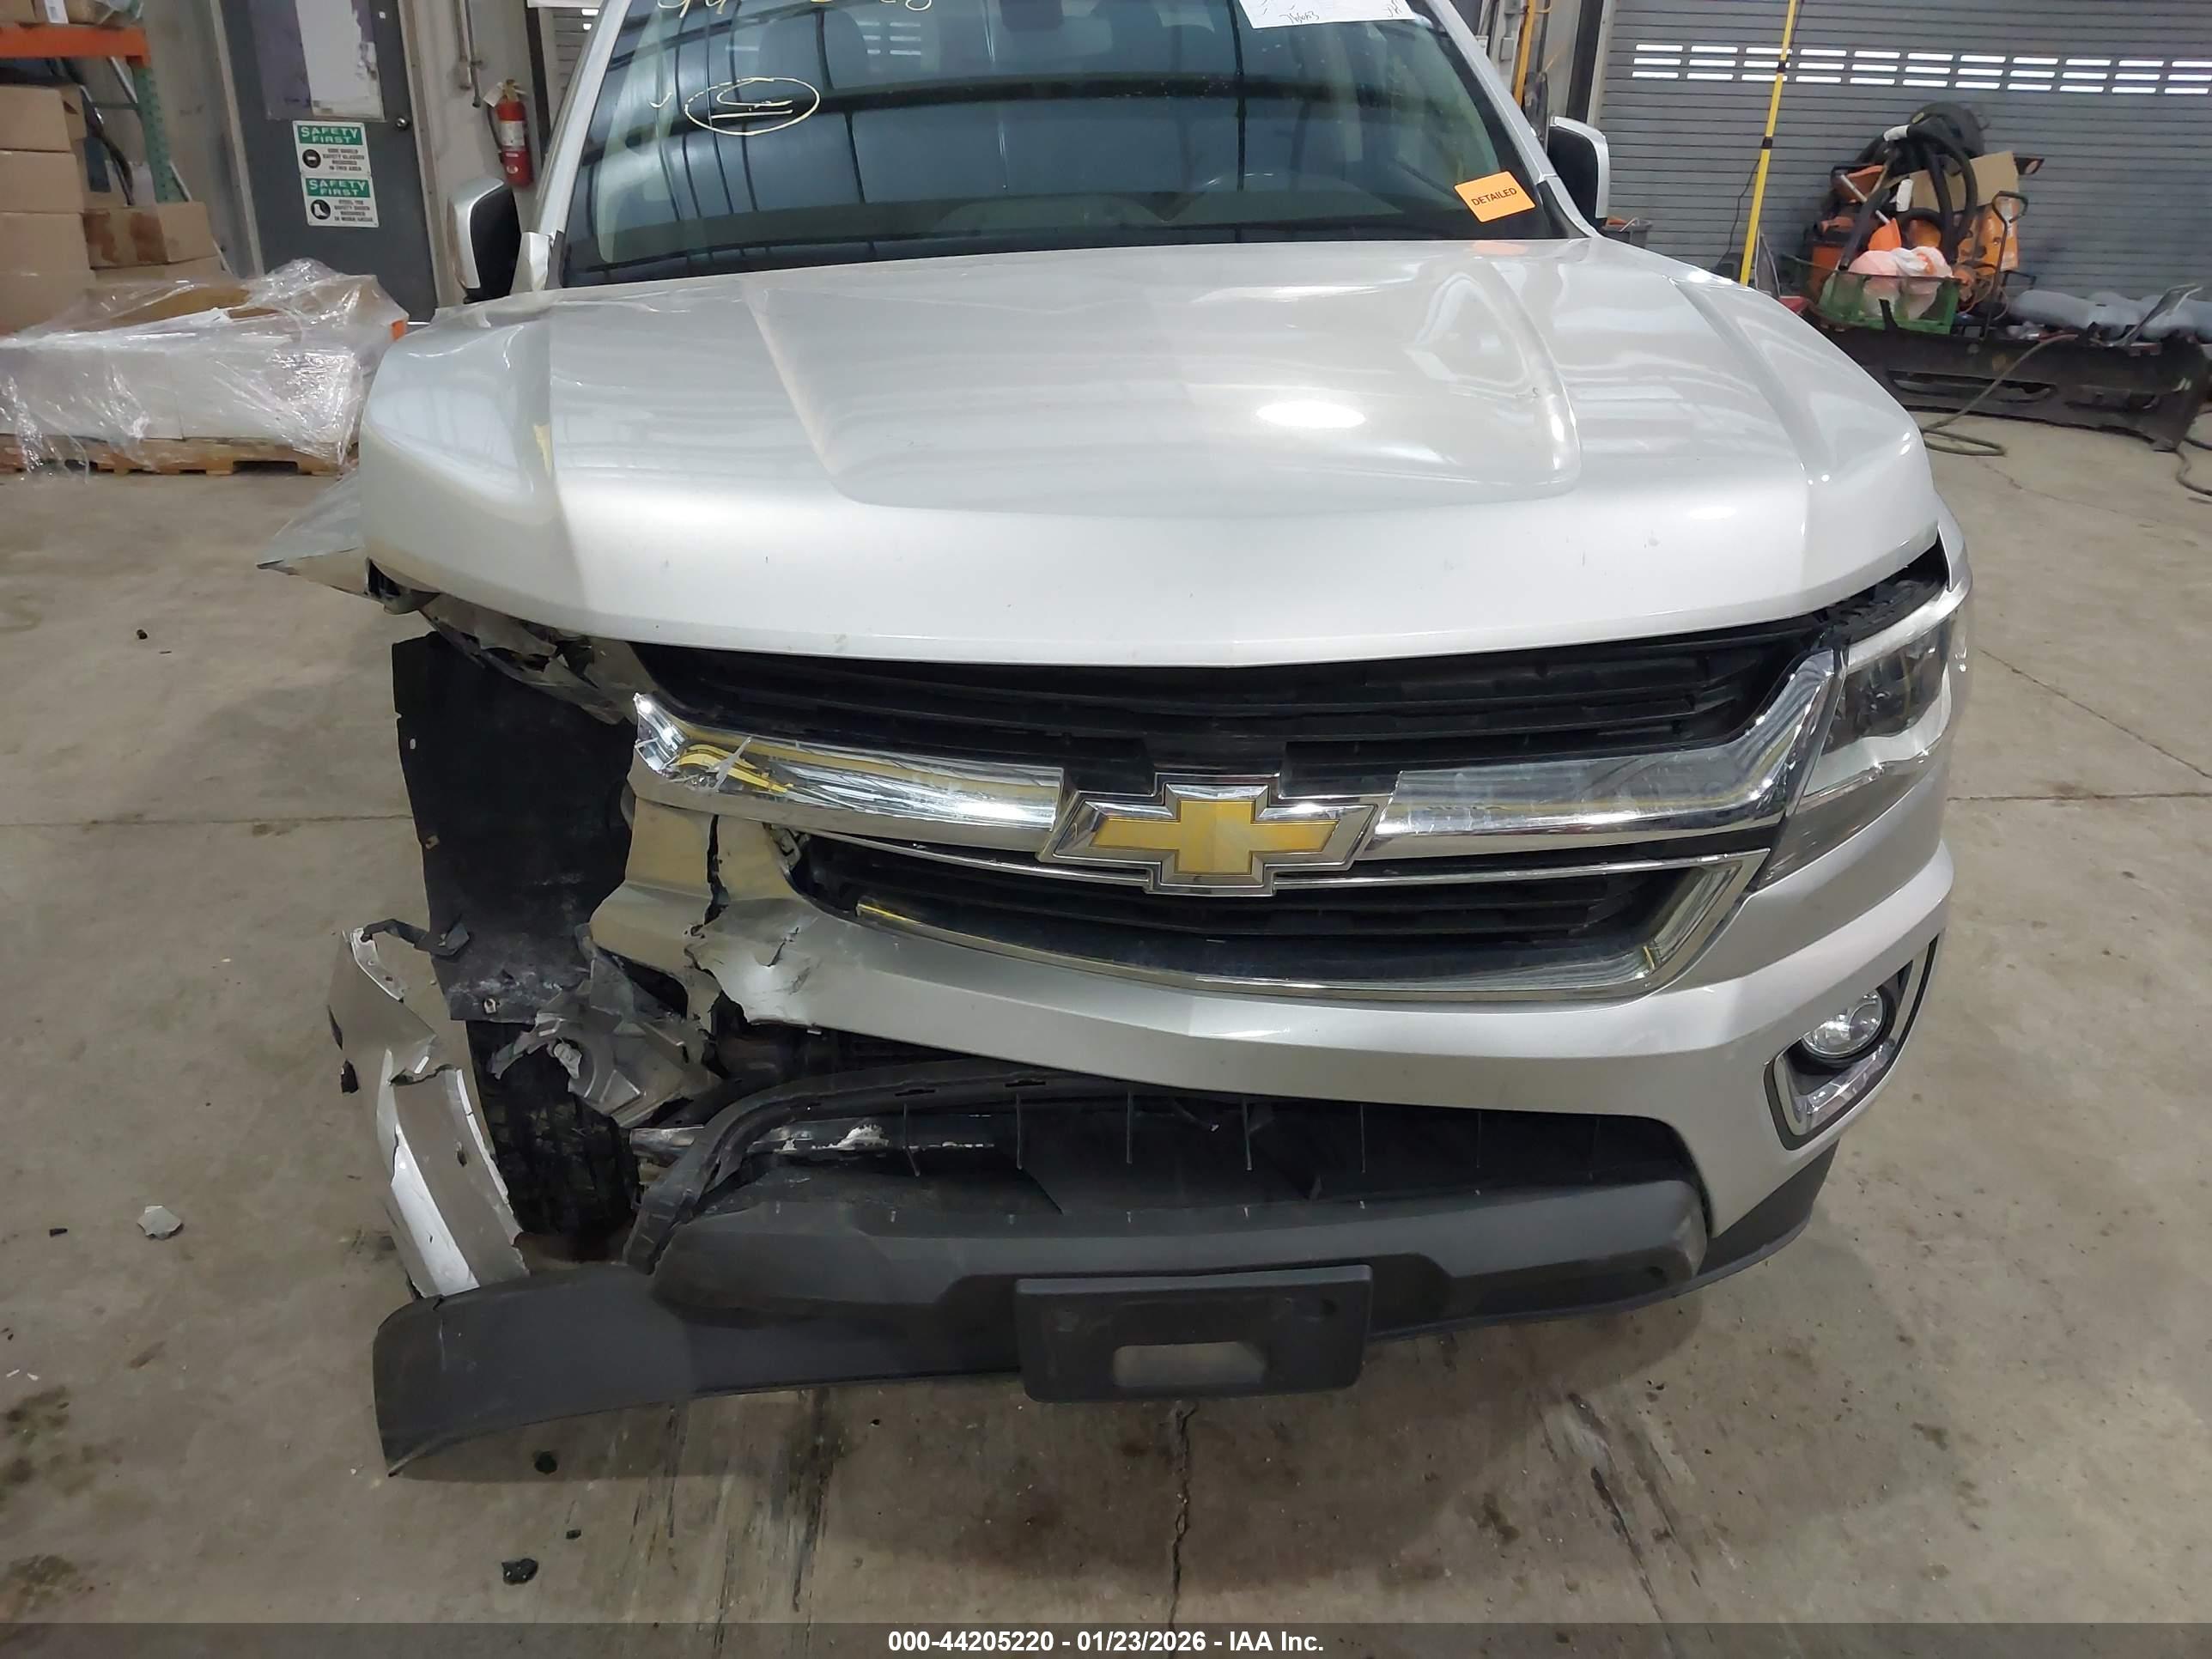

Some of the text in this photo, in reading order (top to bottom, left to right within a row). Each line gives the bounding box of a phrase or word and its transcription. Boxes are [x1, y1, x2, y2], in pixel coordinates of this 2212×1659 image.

[301, 126, 358, 139] SAFETY
[308, 179, 366, 191] SAFETY
[1471, 187, 1517, 206] DETAILED
